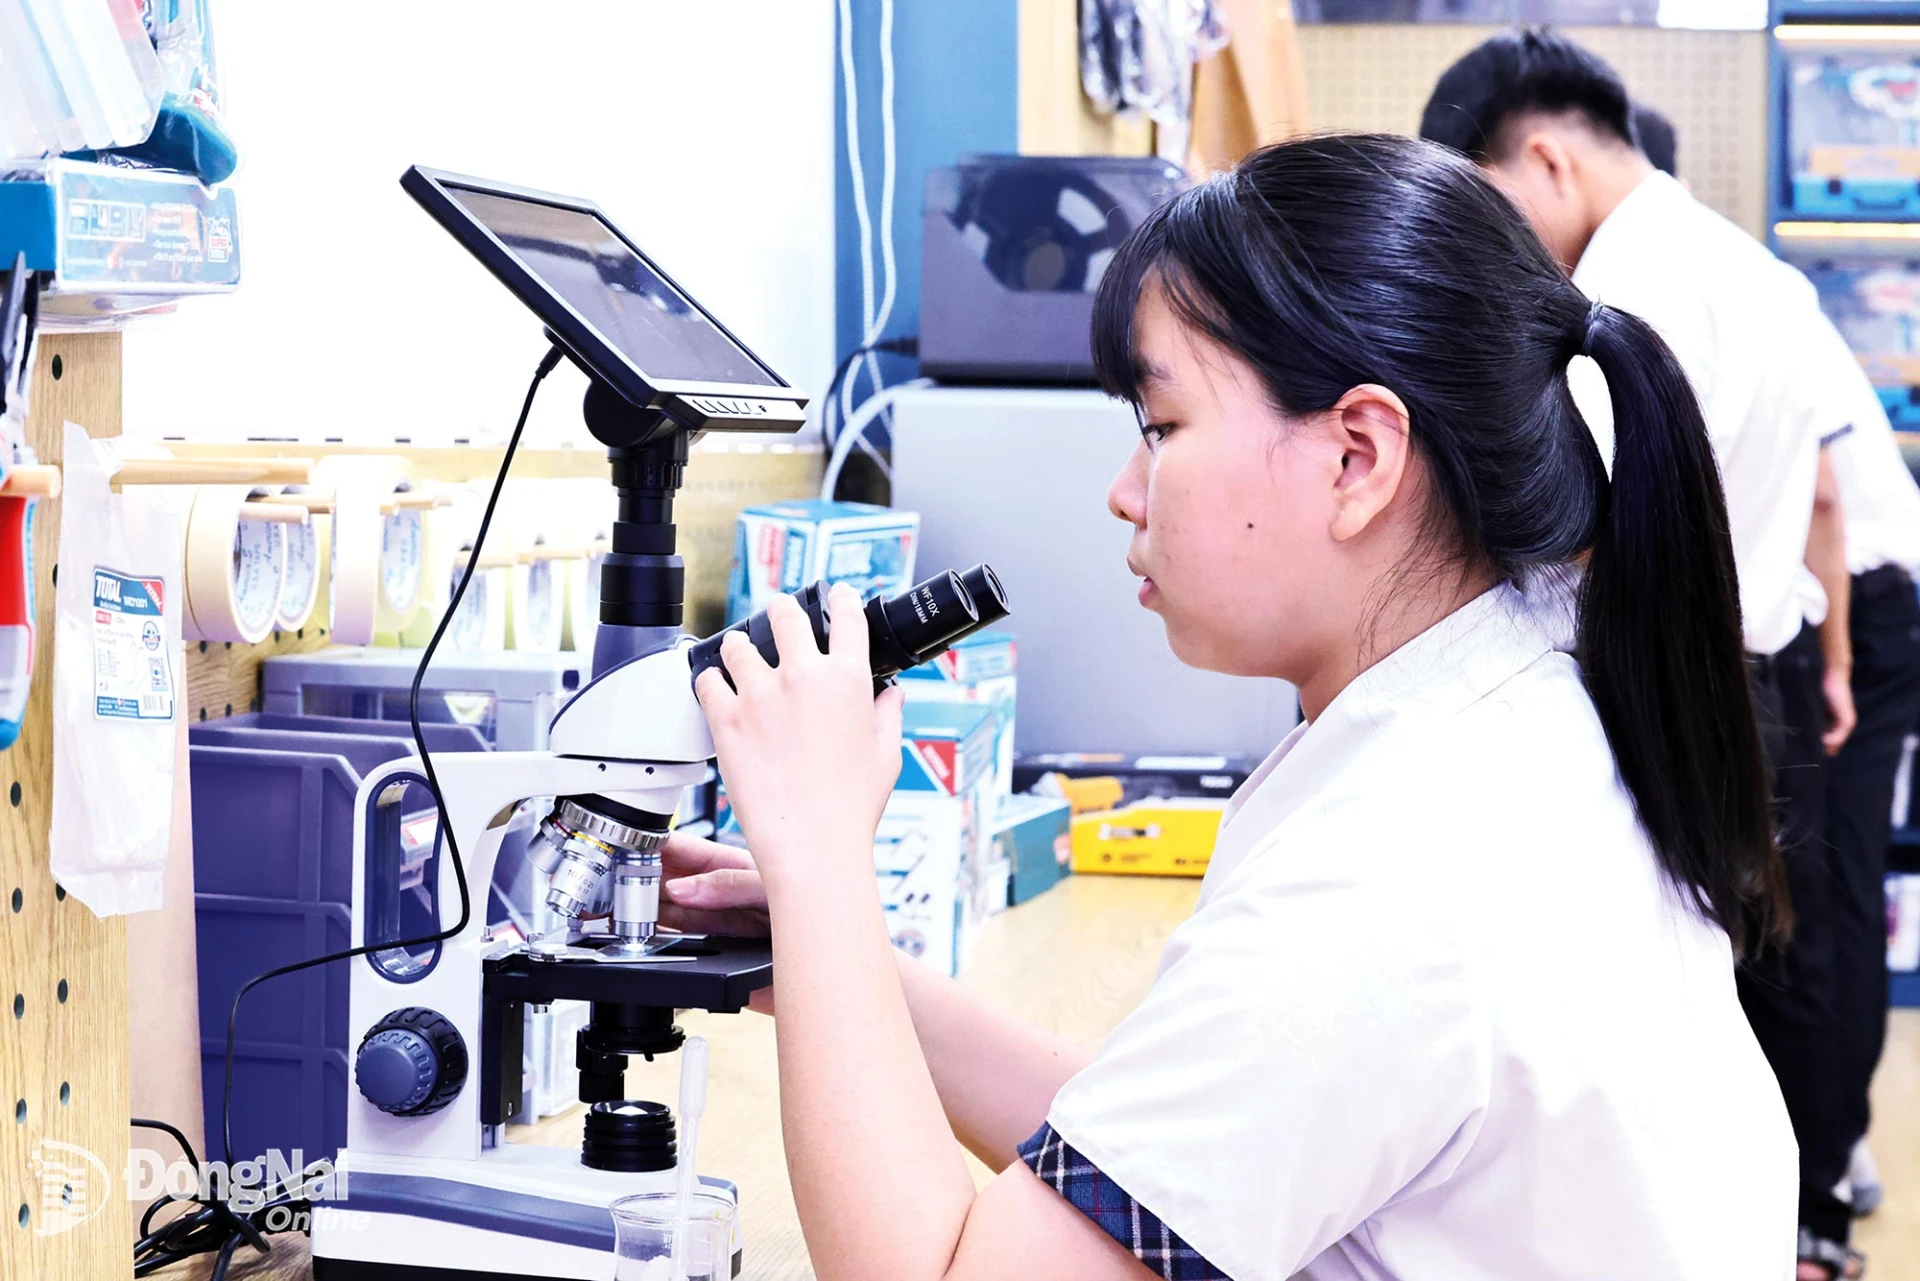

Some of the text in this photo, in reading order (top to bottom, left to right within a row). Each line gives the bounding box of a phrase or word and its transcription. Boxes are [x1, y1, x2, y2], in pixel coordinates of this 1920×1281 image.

[96, 574, 122, 603] TOTAL
[144, 582, 163, 609] TOTAL
[921, 585, 940, 617] WF10X
